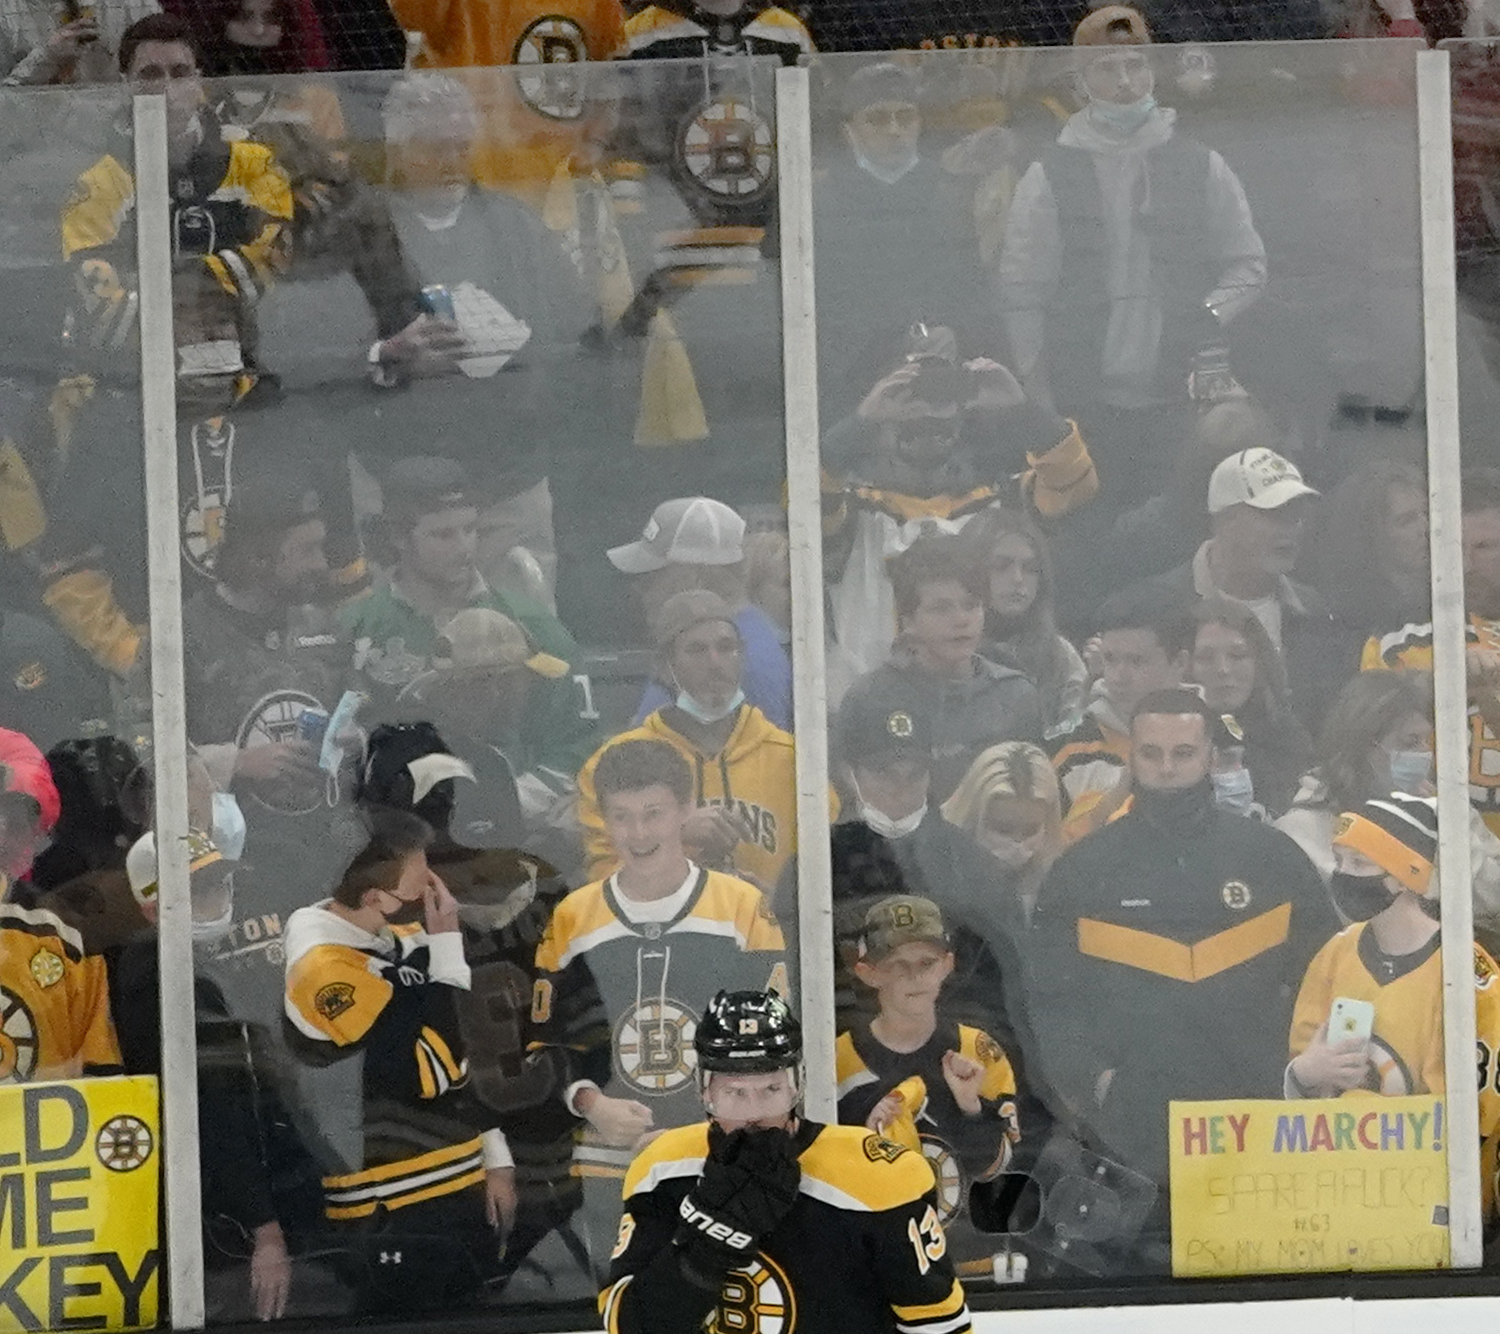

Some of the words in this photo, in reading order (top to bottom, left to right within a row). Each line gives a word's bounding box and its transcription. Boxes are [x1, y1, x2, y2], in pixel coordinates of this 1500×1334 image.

[639, 1018, 684, 1074] B
[115, 1131, 134, 1156] B
[1183, 1113, 1250, 1155] HEY
[1273, 1101, 1443, 1154] MARCHY!
[907, 1204, 948, 1275] 13
[0, 1250, 159, 1334] KEY
